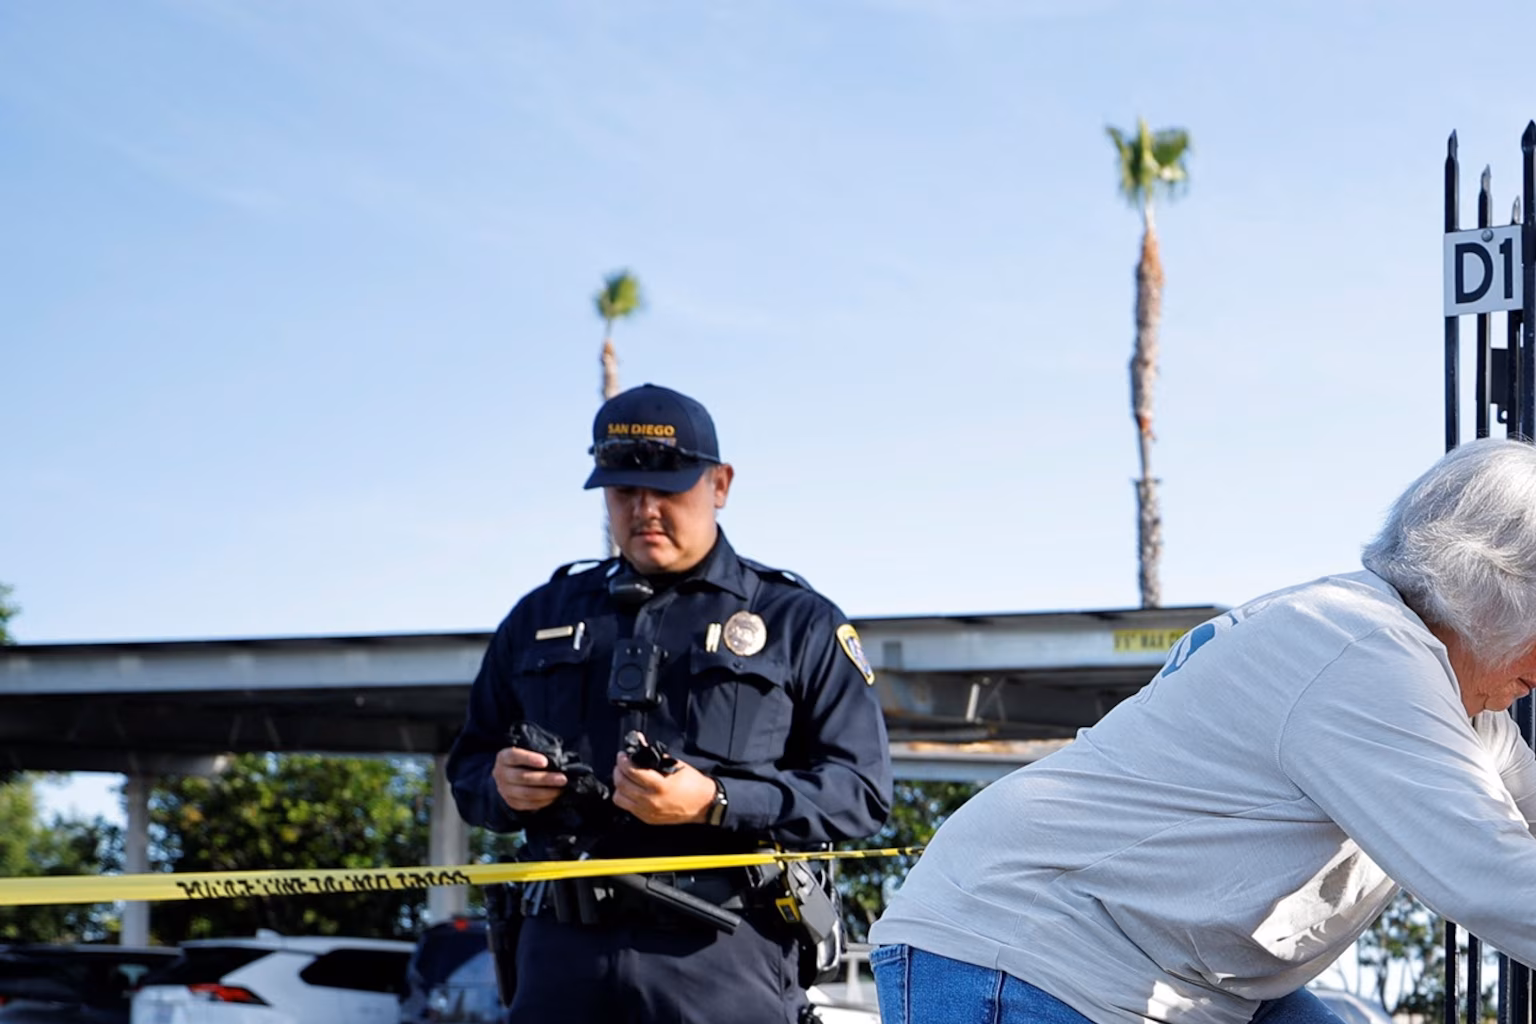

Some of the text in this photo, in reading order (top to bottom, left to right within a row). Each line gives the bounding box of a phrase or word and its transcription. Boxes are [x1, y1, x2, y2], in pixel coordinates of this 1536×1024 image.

[1454, 237, 1514, 304] D1
[607, 423, 676, 437] SAN DIEGO
